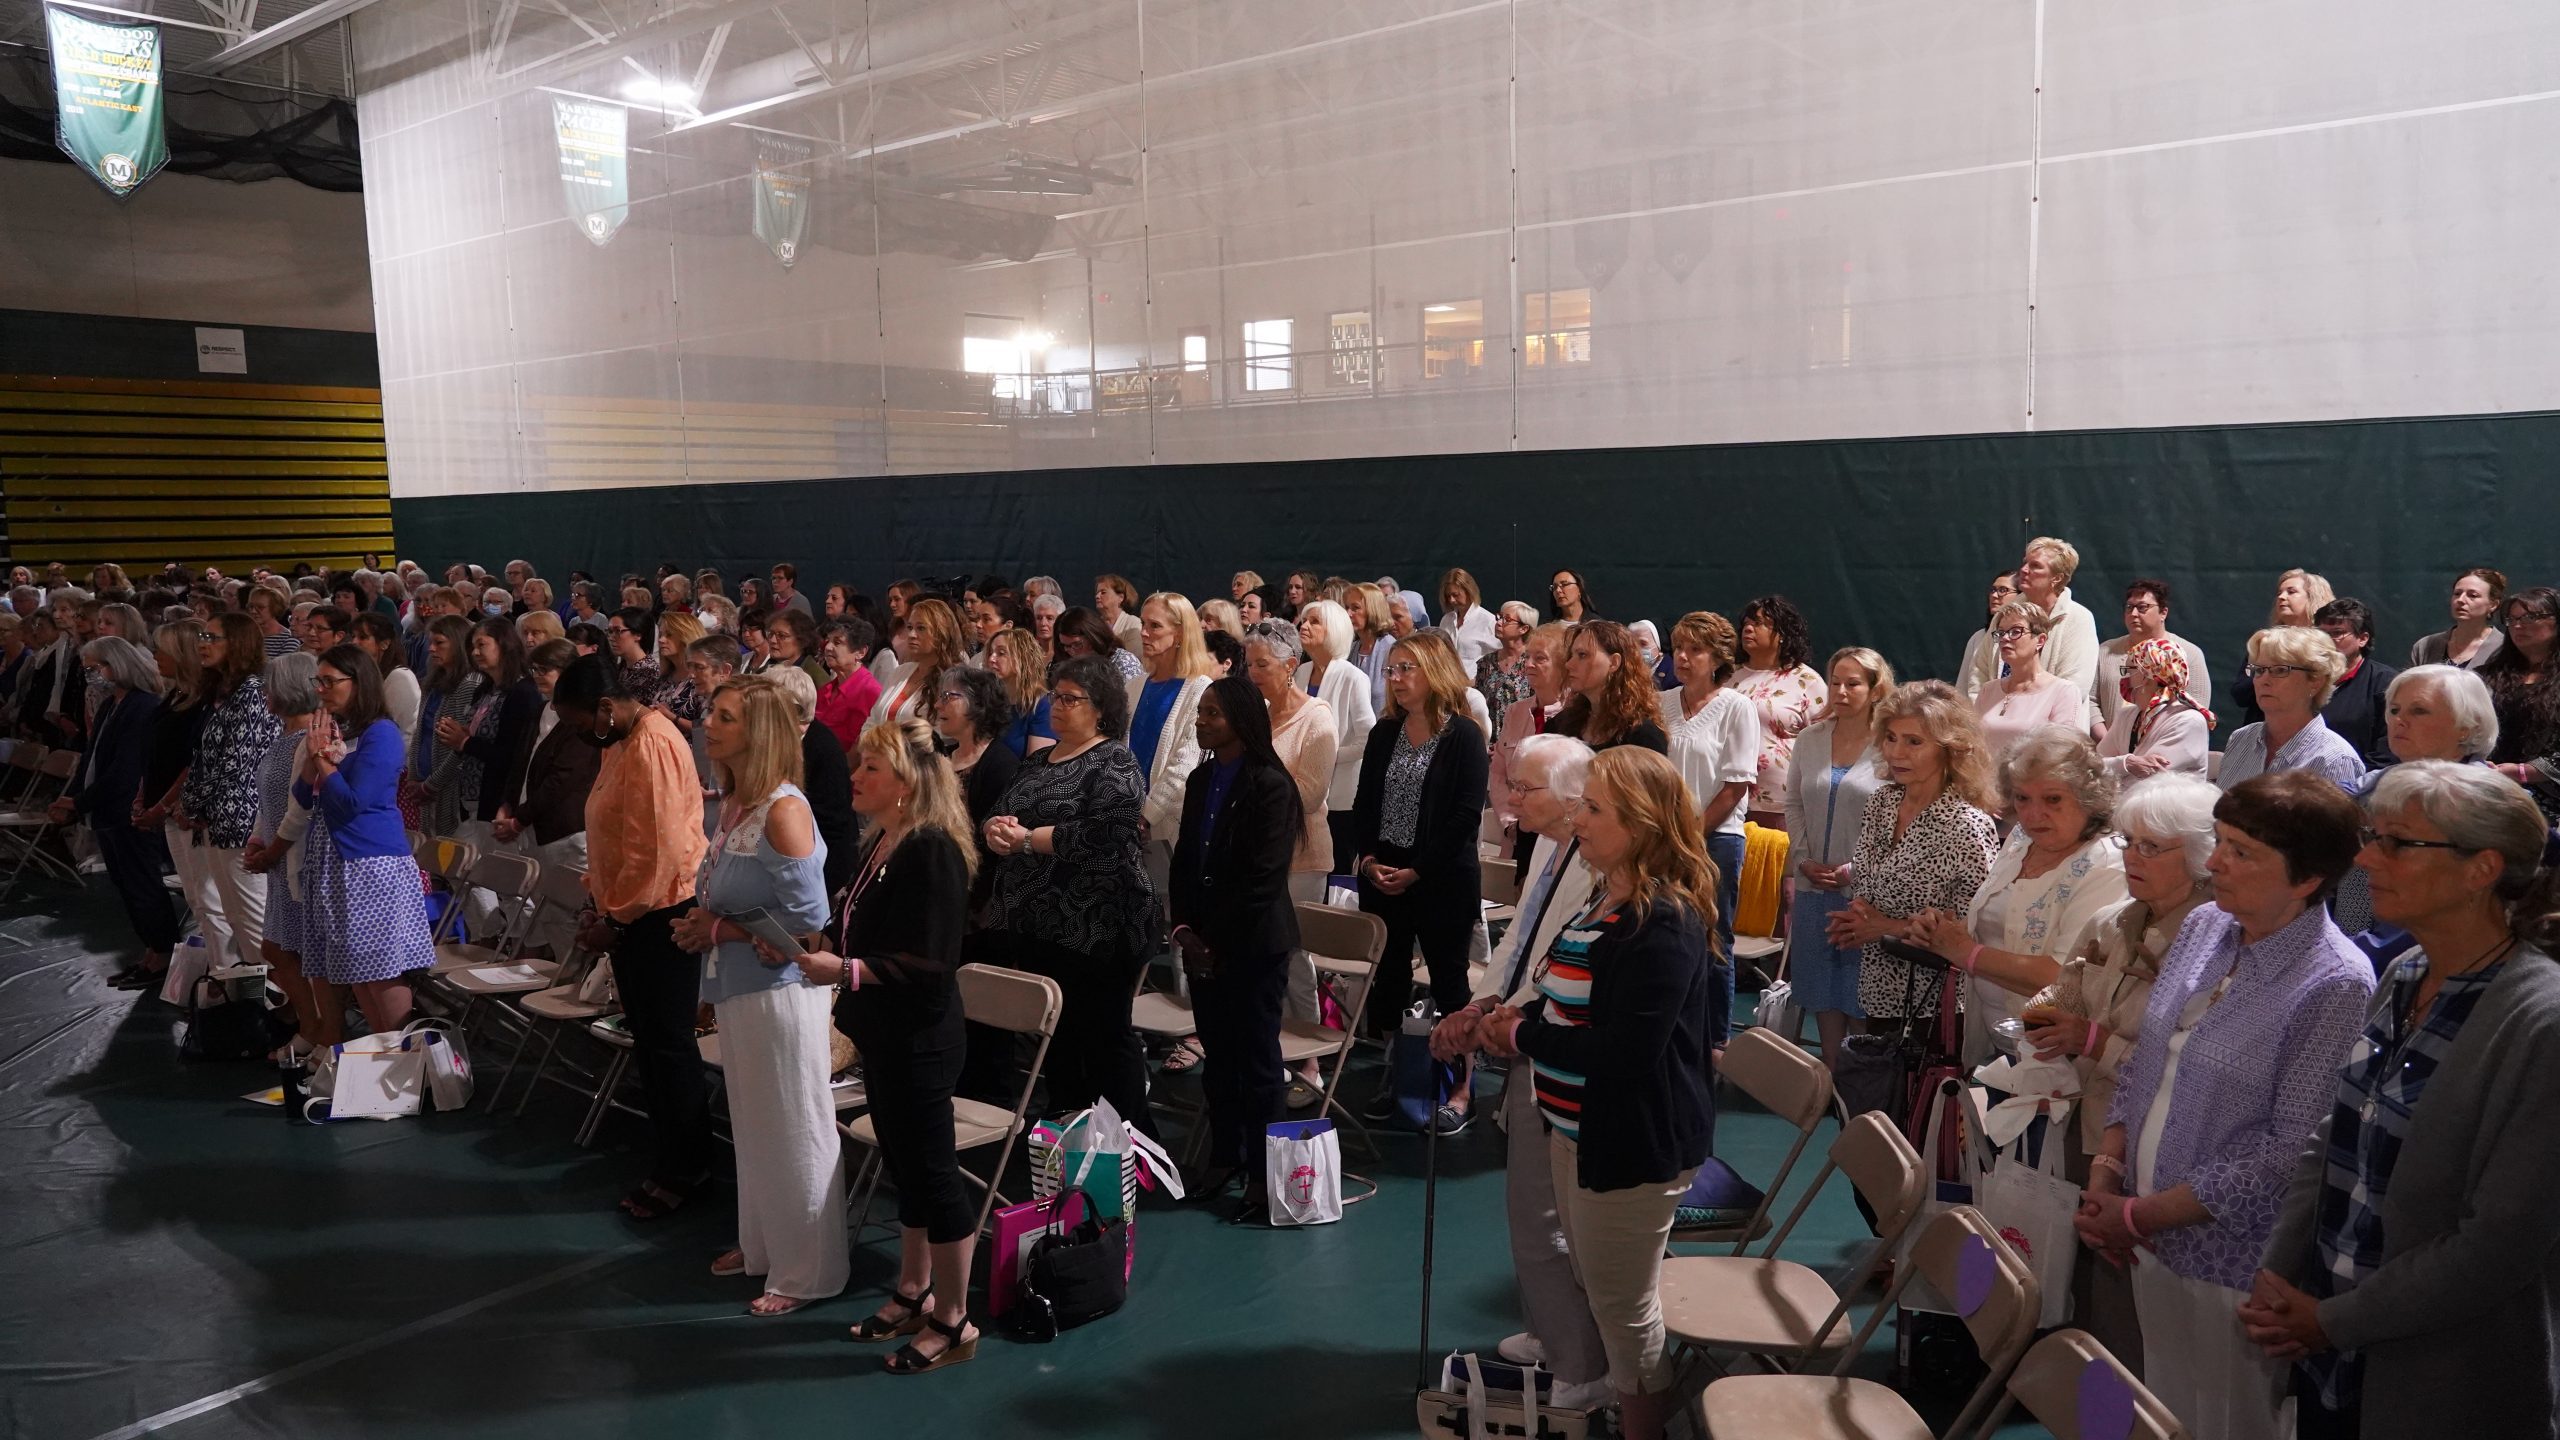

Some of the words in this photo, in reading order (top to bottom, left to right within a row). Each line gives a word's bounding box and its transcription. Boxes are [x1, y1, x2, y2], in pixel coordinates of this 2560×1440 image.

[62, 19, 154, 41] WOOD
[119, 103, 144, 114] EAST
[110, 162, 128, 178] M
[591, 220, 603, 232] M
[783, 246, 793, 256] M
